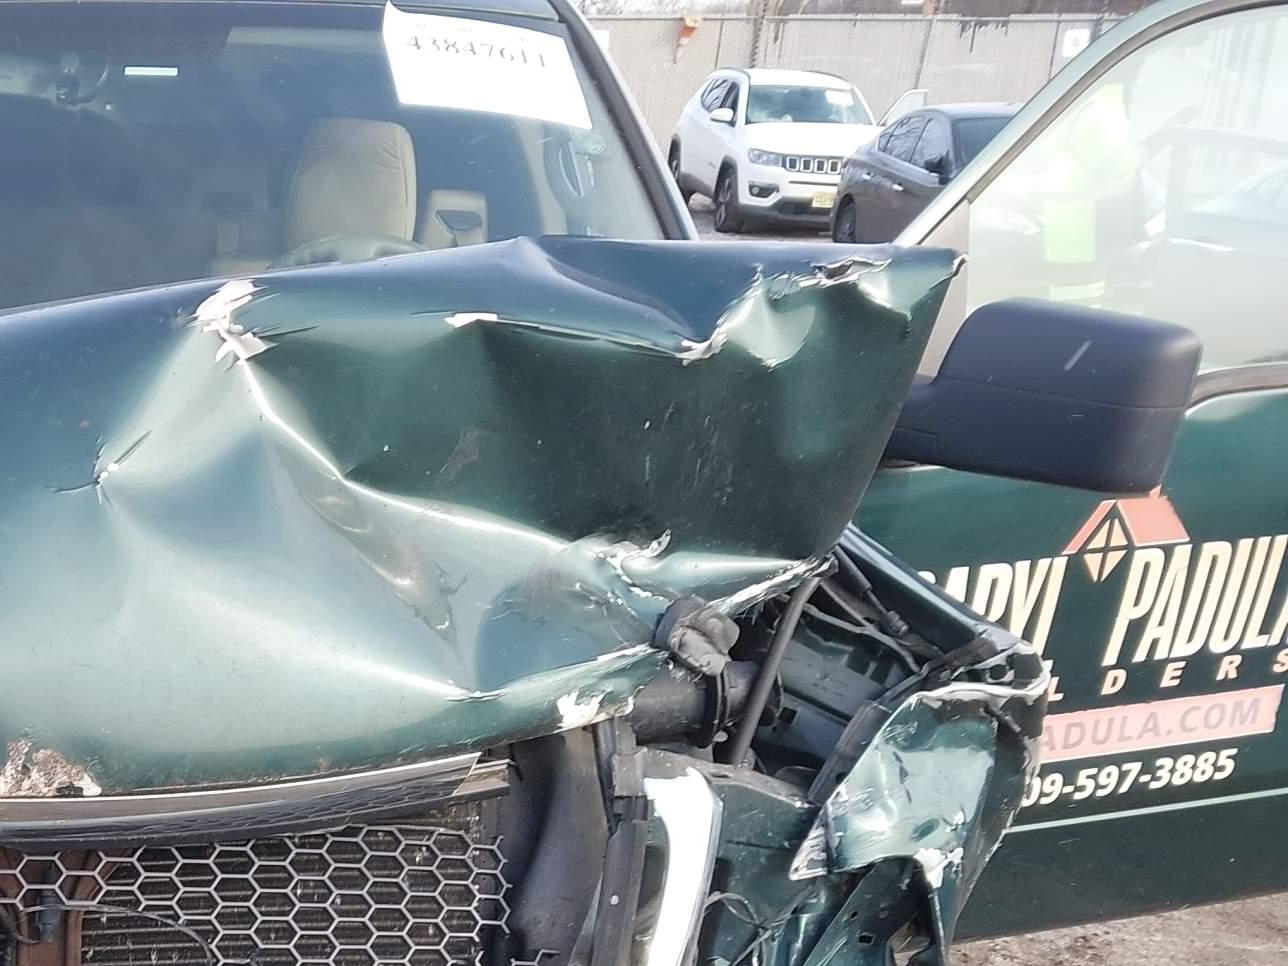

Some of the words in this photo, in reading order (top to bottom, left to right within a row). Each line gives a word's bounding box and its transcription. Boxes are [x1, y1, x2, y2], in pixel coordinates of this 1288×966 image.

[1046, 654, 1288, 701] LDERS
[1042, 698, 1261, 751] ADULA.COM
[1021, 748, 1239, 808] 09-597-3885
